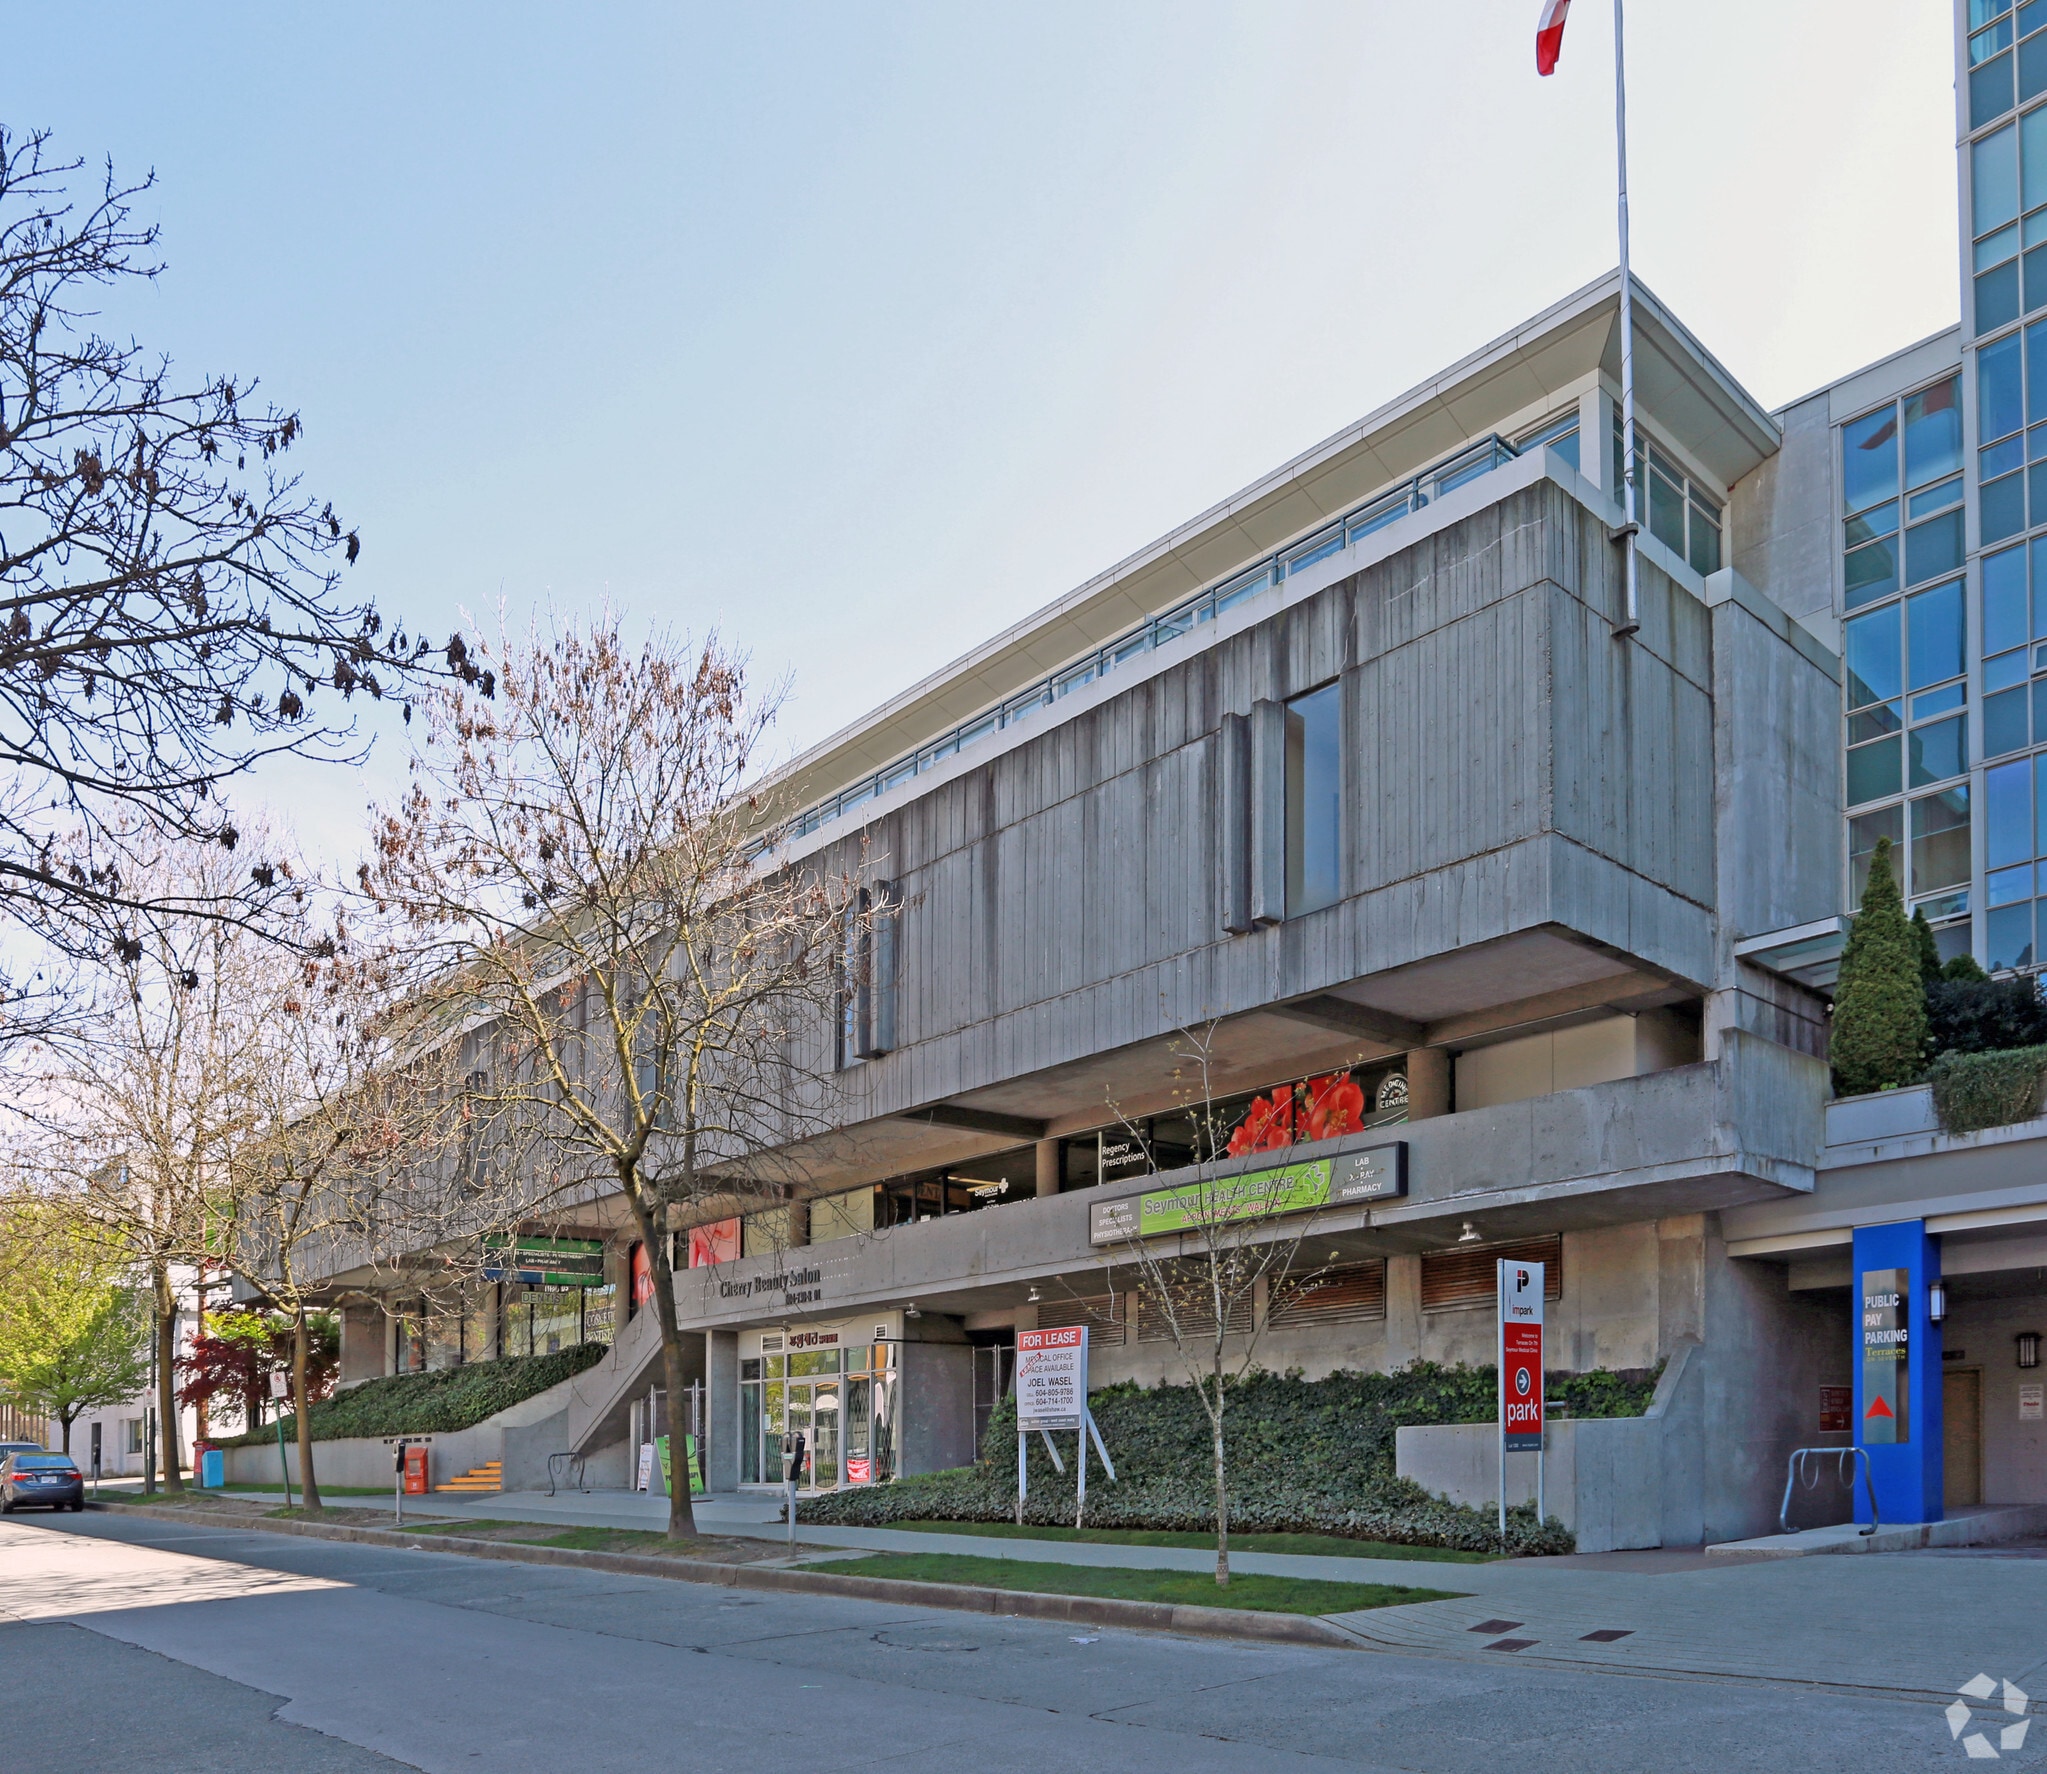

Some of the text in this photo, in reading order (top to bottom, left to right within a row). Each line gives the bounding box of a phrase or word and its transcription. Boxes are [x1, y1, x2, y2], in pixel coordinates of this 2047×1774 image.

[1380, 1094, 1408, 1109] CENTRE
[1102, 1142, 1130, 1156] Regency
[1102, 1152, 1145, 1168] Prescriptions
[1355, 1156, 1370, 1166] LAB
[974, 1186, 999, 1197] Seymour
[1144, 1194, 1201, 1216] Seymour
[1249, 1176, 1295, 1196] CENTRE
[1342, 1182, 1382, 1197] PHARMACY
[720, 1268, 820, 1298] Cherry Beauty Salon
[522, 1292, 567, 1304] DENTIST
[1865, 1294, 1900, 1309] PUBLIC
[1512, 1304, 1534, 1317] impark
[1865, 1314, 1882, 1327] PAY
[1022, 1331, 1076, 1348] FOR LEASE
[1865, 1329, 1908, 1344] PARKING
[1052, 1353, 1073, 1361] OFFICE
[1865, 1347, 1906, 1357] Terraces
[1044, 1363, 1074, 1373] AVAILABLE
[1028, 1376, 1072, 1387] JOEL WASEL
[1036, 1396, 1074, 1406] 604-714-1700
[1507, 1398, 1538, 1427] park
